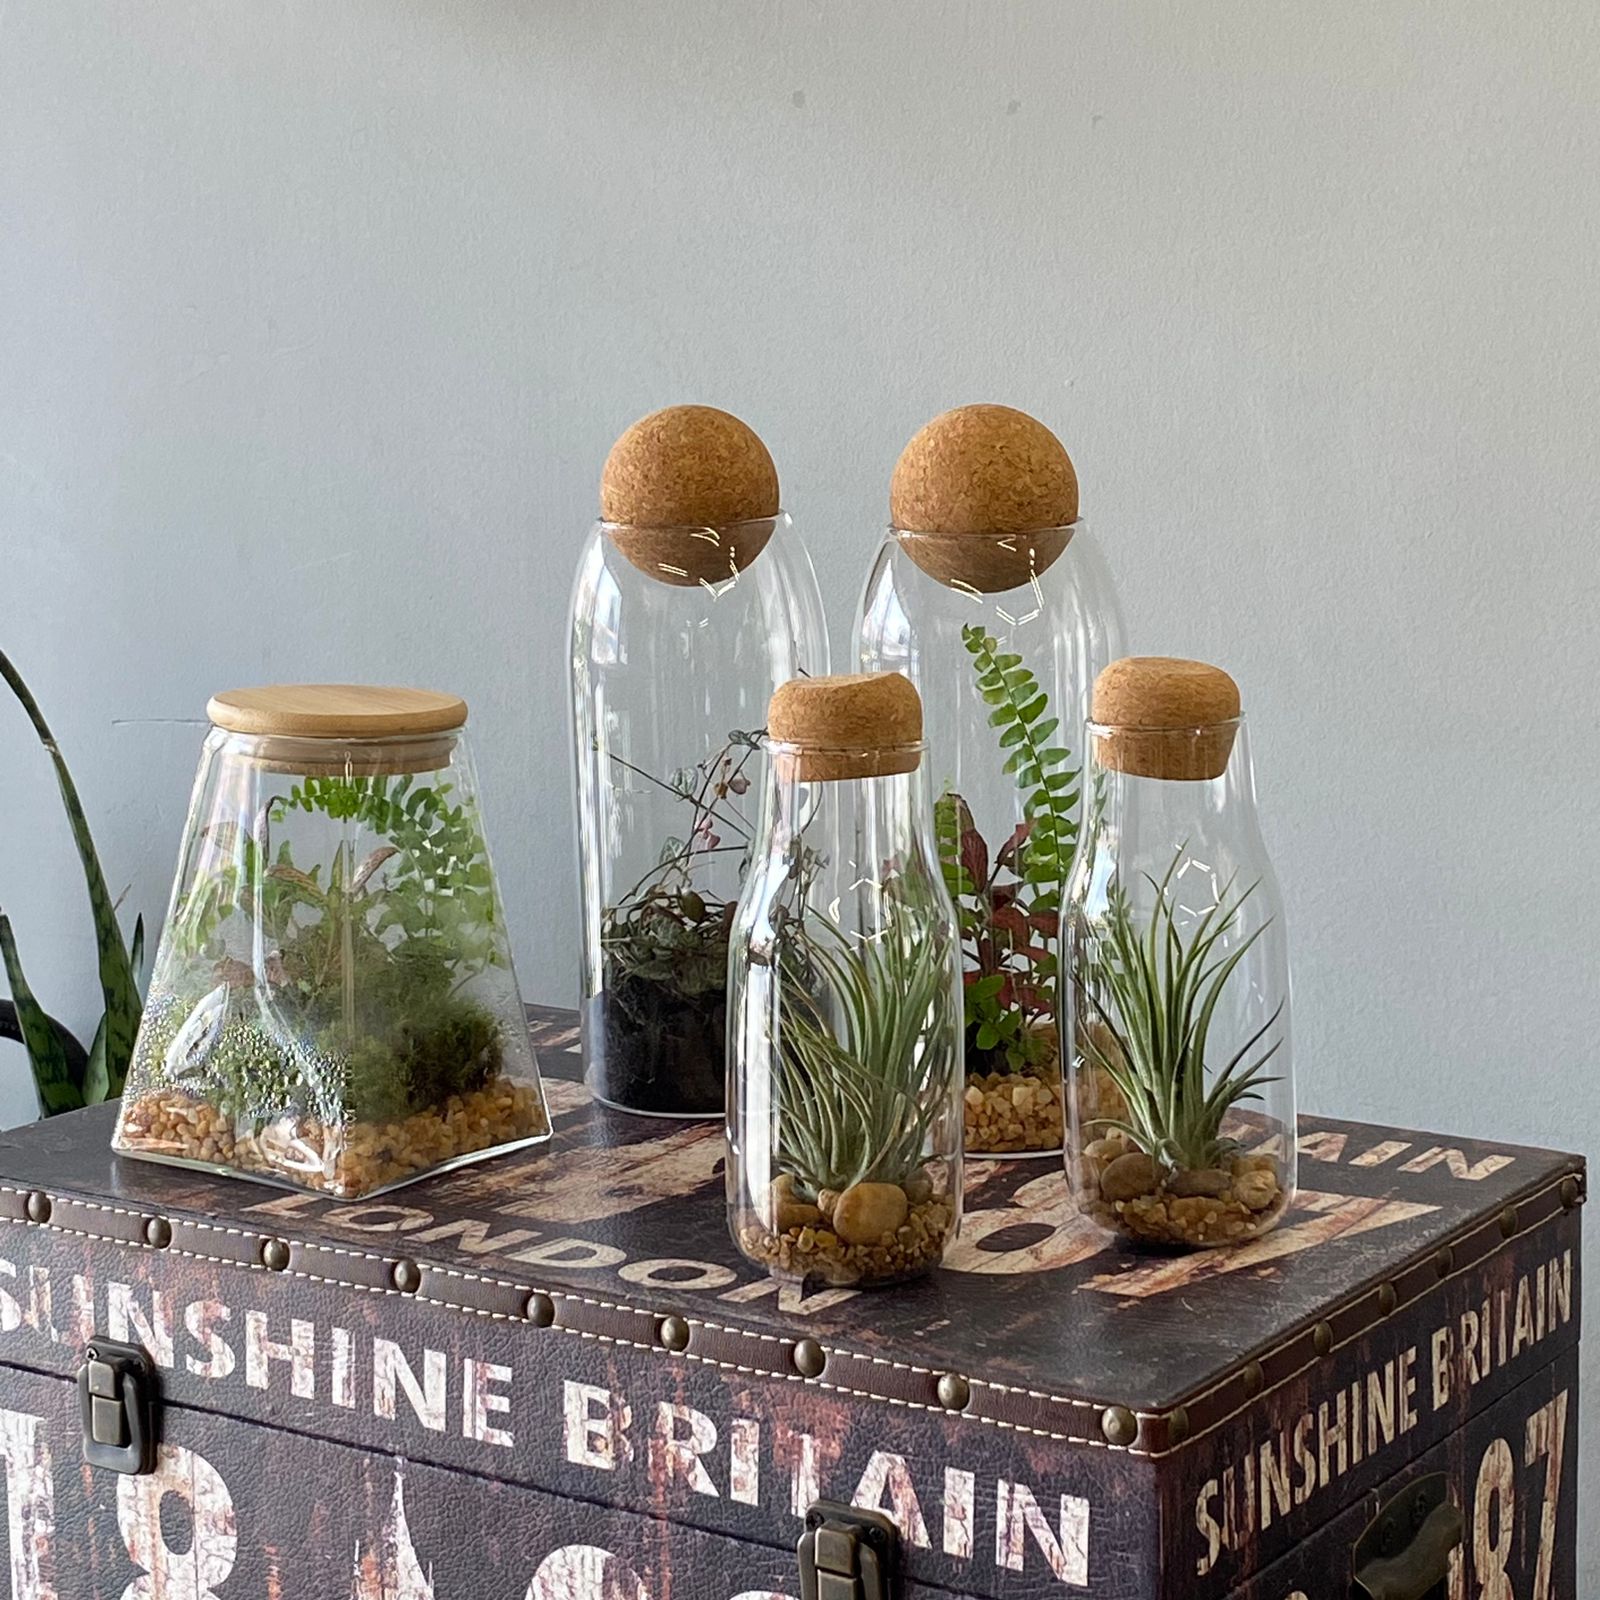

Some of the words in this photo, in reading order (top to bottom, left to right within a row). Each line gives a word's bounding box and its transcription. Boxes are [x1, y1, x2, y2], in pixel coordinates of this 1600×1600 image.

[239, 1193, 863, 1316] LONDON
[563, 1380, 1090, 1587] BRITAIN
[1195, 1345, 1418, 1576] SUNSHINE
[1432, 1249, 1572, 1412] BRITAIN
